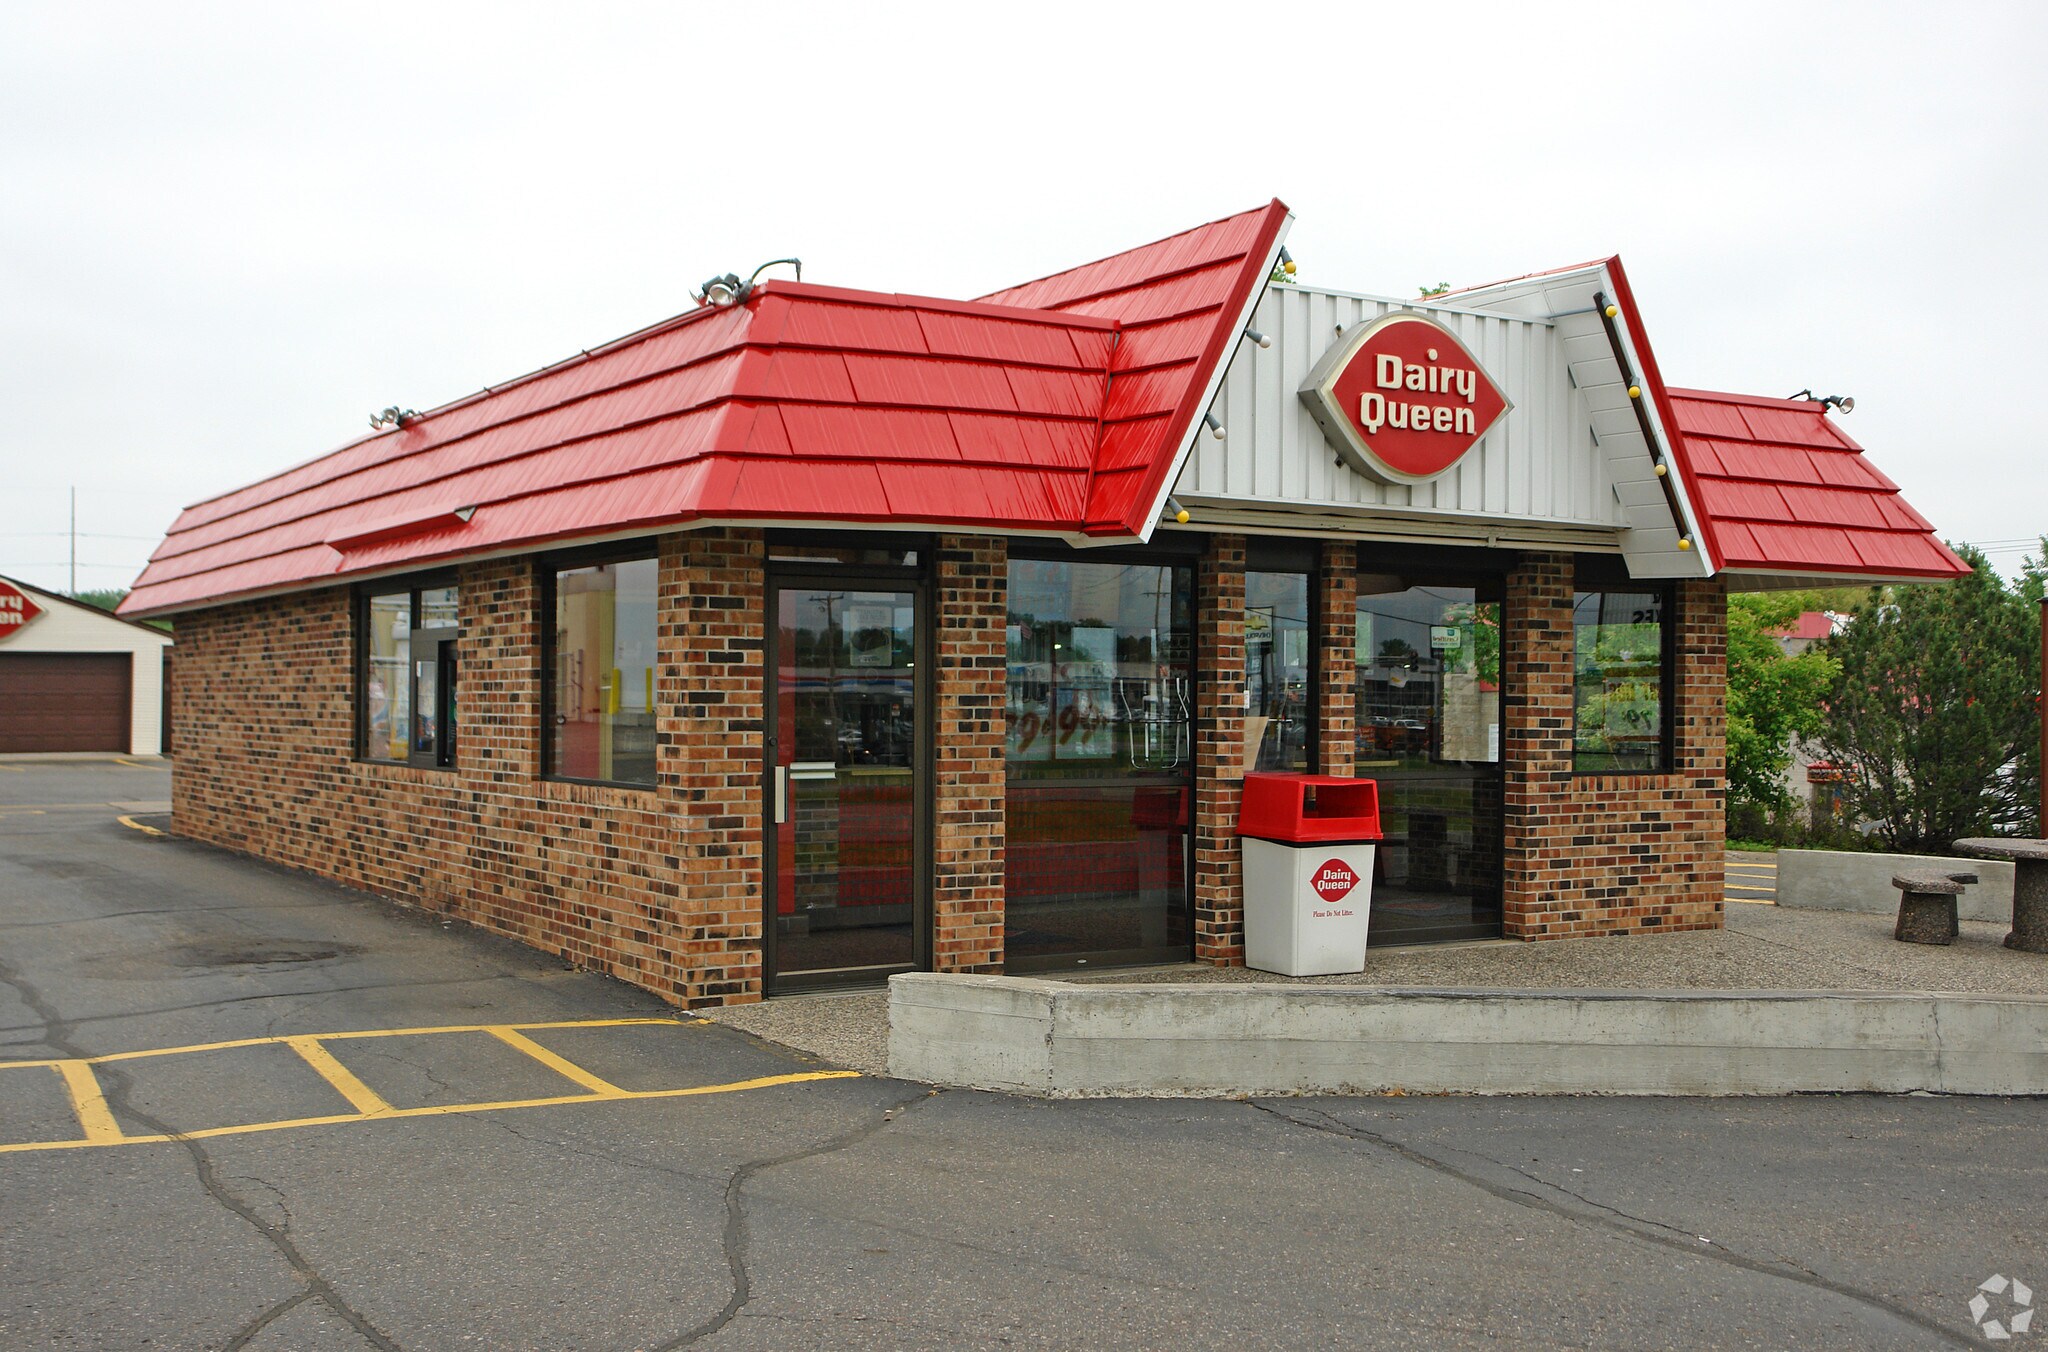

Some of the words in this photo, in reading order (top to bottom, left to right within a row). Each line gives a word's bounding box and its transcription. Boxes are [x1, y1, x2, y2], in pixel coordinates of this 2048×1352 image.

[1376, 348, 1476, 403] Dairy
[1360, 392, 1476, 435] Queen
[1318, 880, 1350, 891] Queen
[1323, 869, 1351, 880] Dairy
